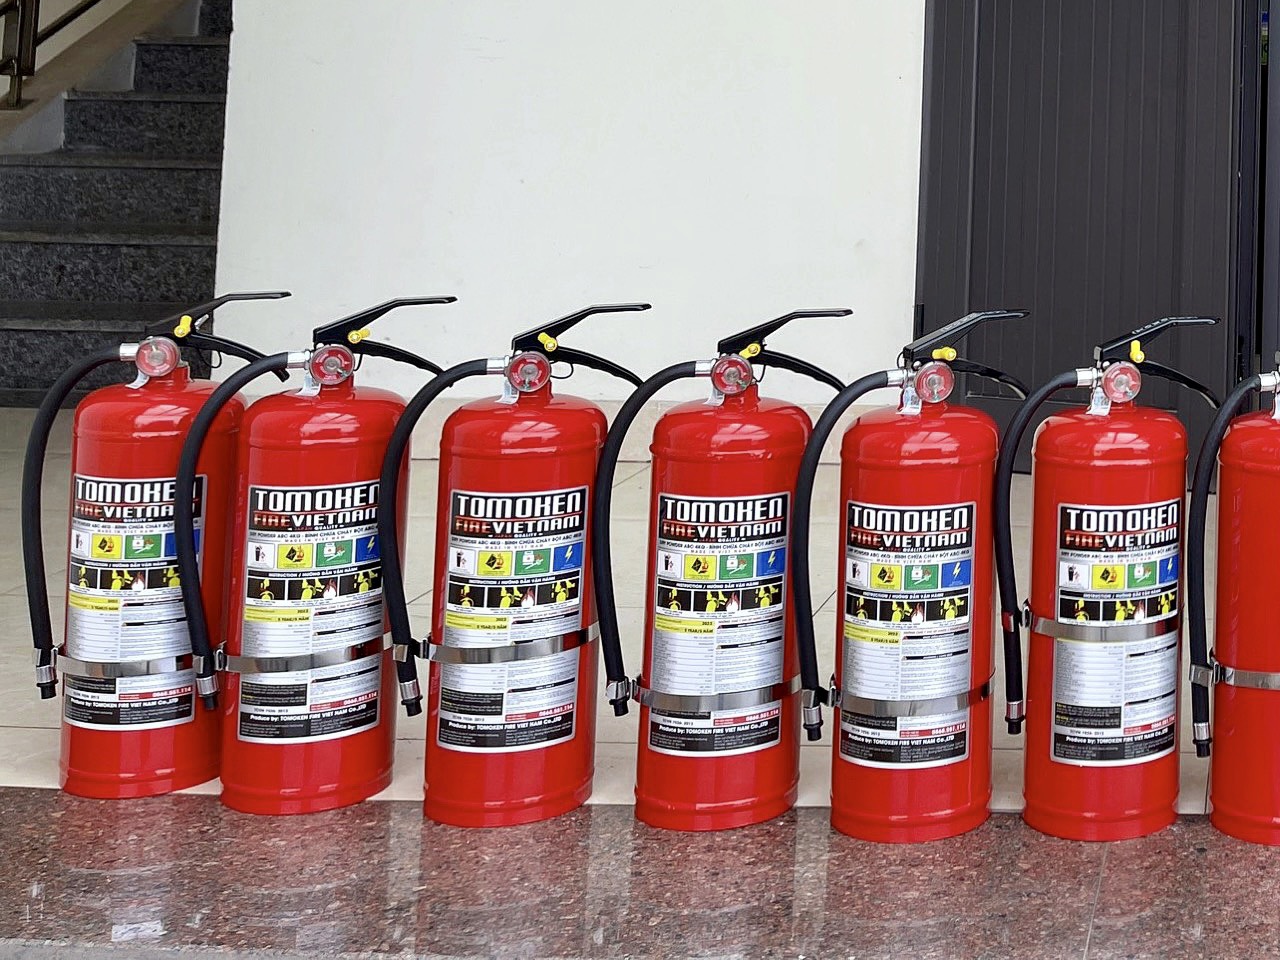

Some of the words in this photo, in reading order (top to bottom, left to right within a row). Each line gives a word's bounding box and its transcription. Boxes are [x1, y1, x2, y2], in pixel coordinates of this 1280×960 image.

[76, 479, 196, 503] TOMOKE
[458, 492, 581, 518] TOMOKEN
[664, 498, 783, 523] TOMOKEN
[492, 515, 580, 534] VIETNAM
[696, 521, 782, 538] VIETNAM
[852, 506, 968, 532] TOMOKEN
[1066, 503, 1178, 532] TOMOKEN
[881, 531, 968, 549] VIETNAM
[1103, 528, 1178, 548] VIETNAM
